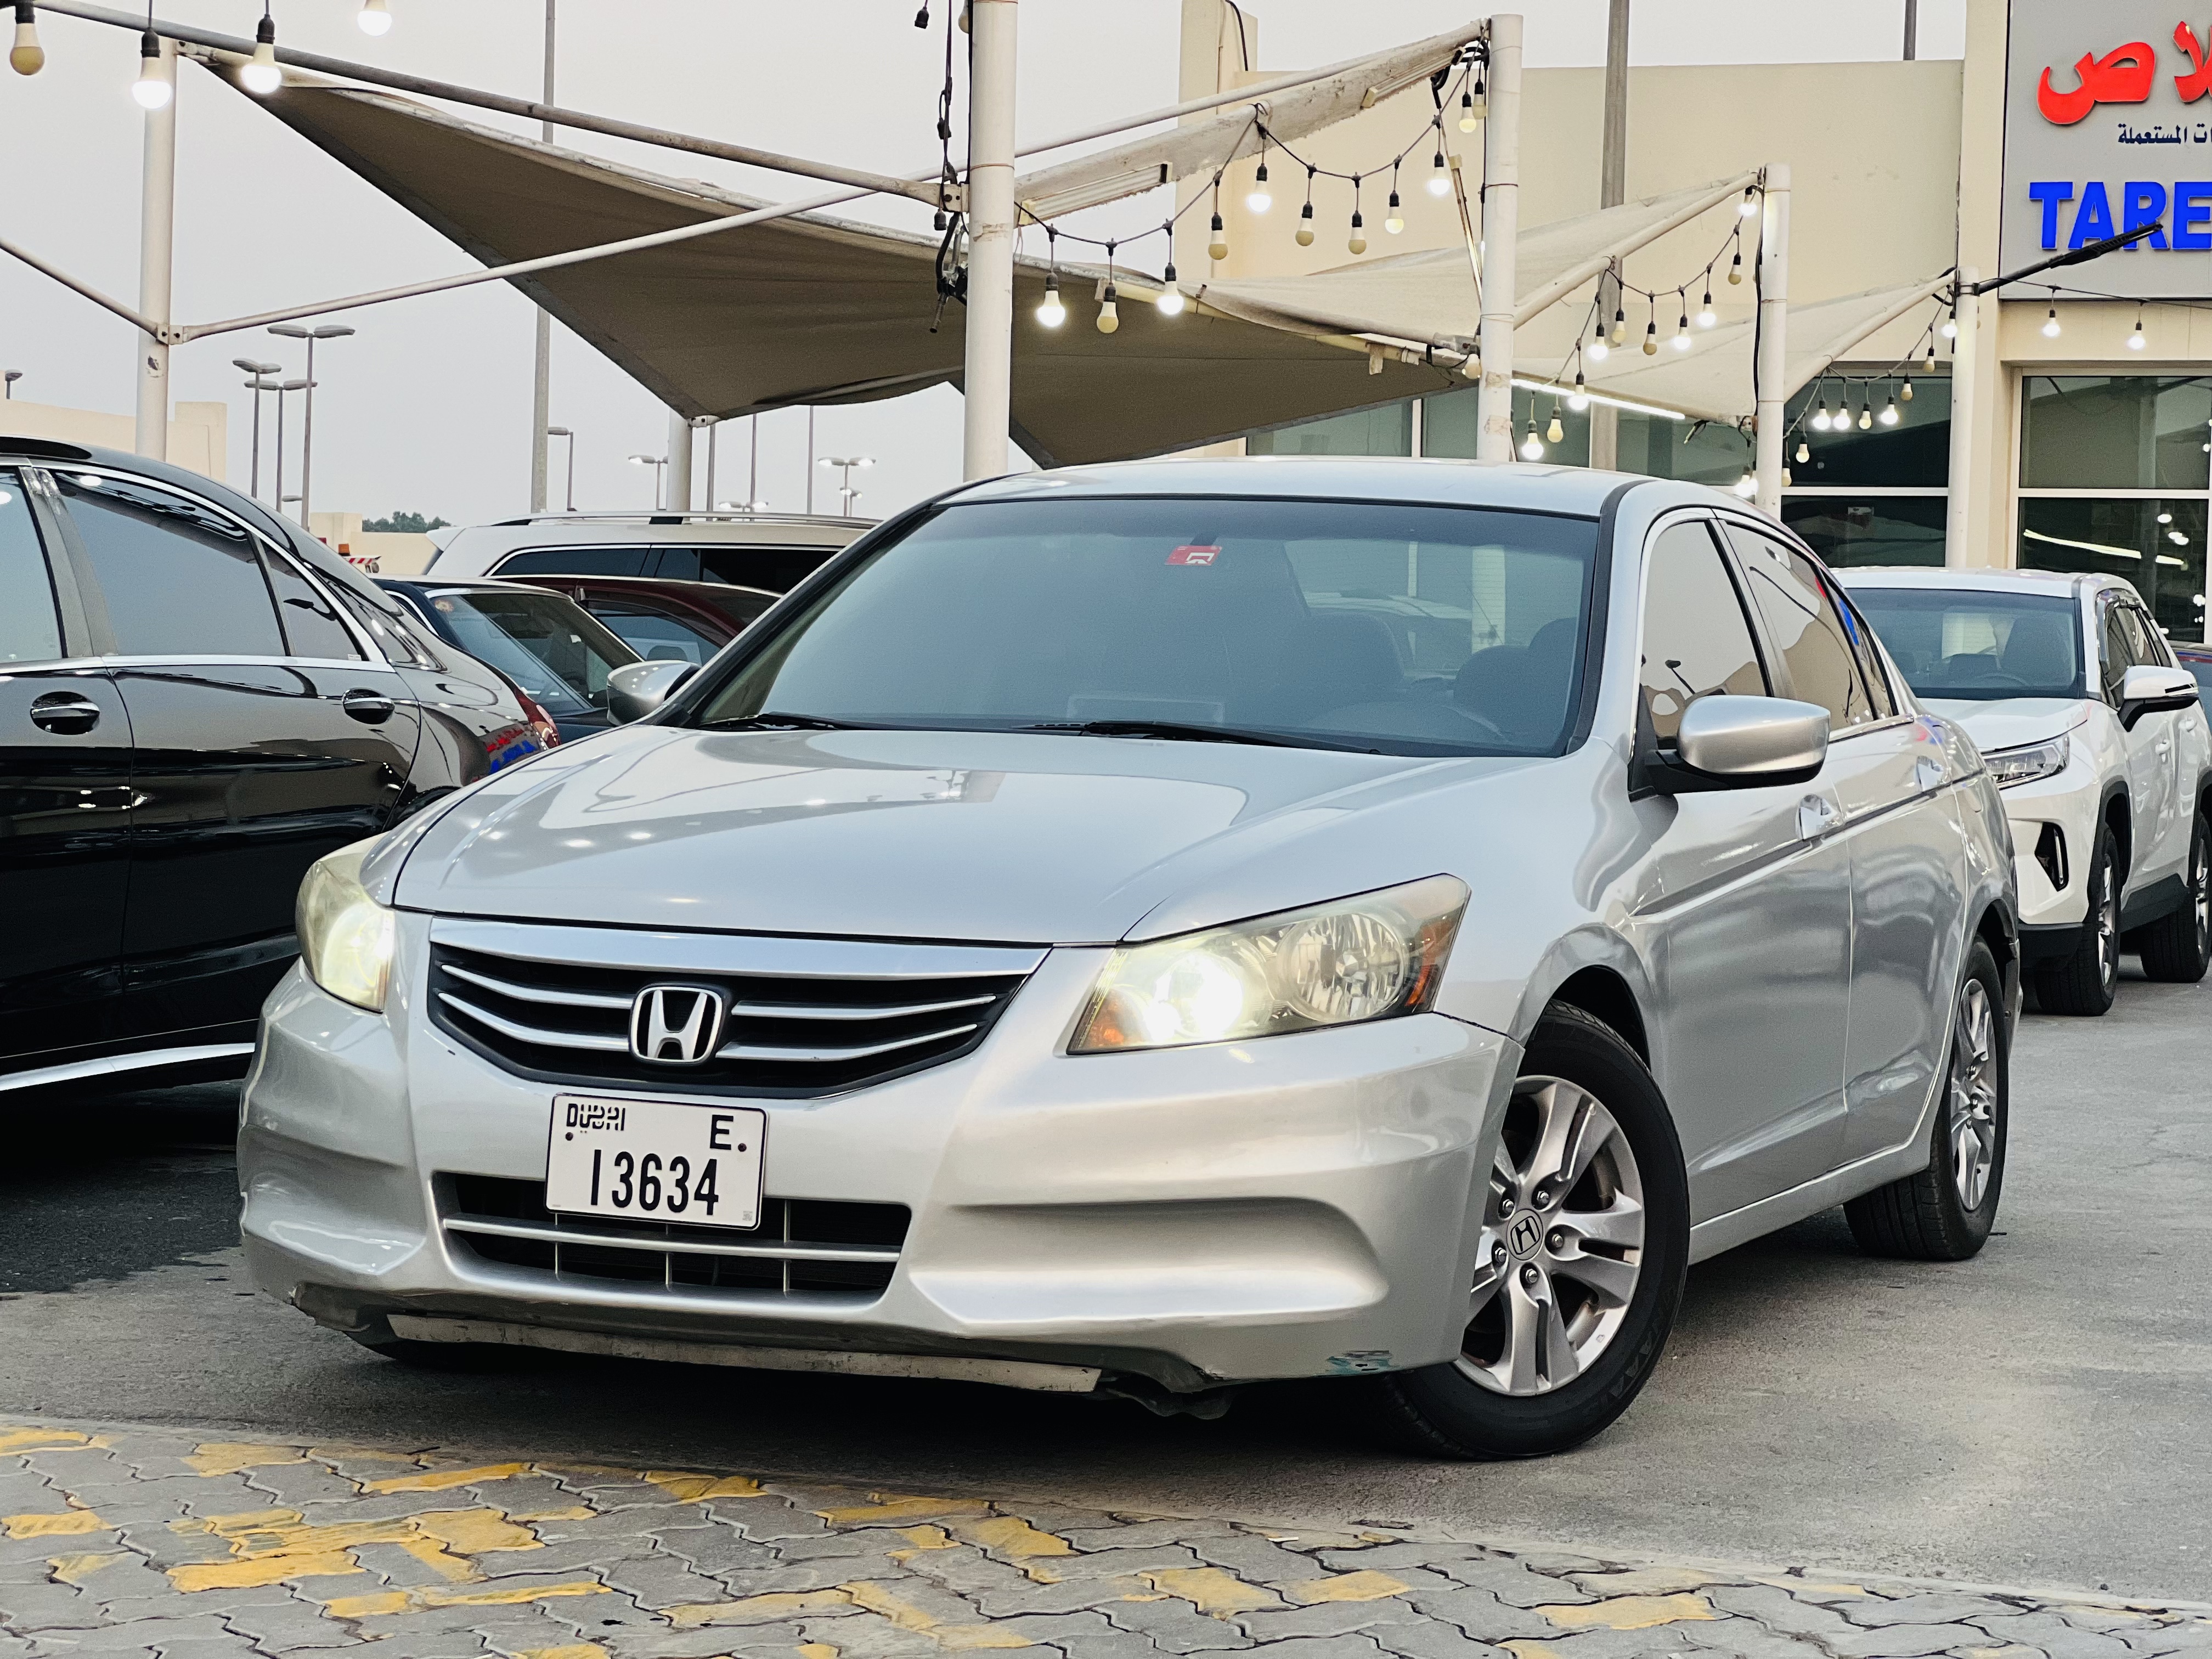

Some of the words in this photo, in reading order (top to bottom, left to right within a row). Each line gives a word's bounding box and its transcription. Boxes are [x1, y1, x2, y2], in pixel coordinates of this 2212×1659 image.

[2118, 123, 2187, 145] المستعملة
[2029, 181, 2212, 250] TARE
[709, 1114, 734, 1150] E
[590, 1149, 719, 1216] 13634
